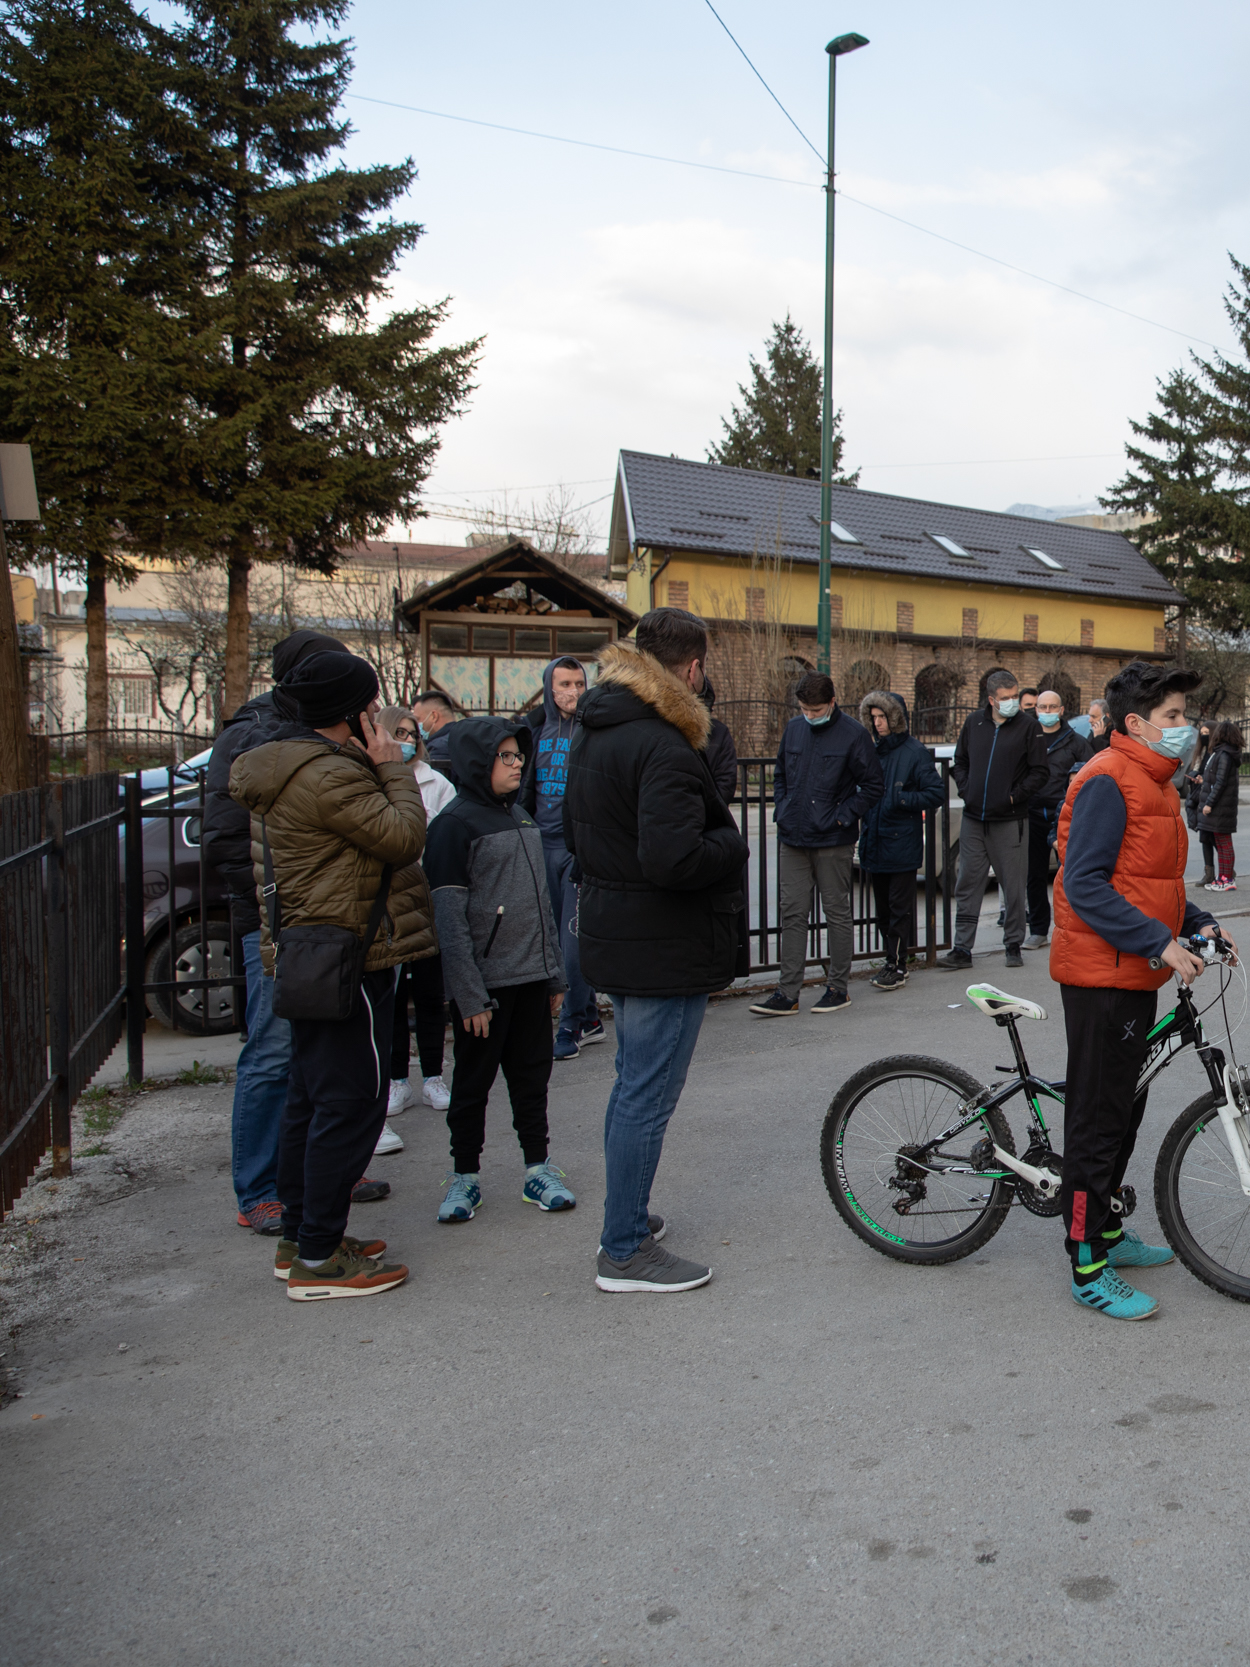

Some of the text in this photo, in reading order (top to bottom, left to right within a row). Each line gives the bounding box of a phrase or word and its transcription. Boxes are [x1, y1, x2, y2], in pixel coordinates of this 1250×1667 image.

[538, 738, 553, 753] BE
[550, 752, 566, 766] OR
[541, 782, 566, 796] 1975
